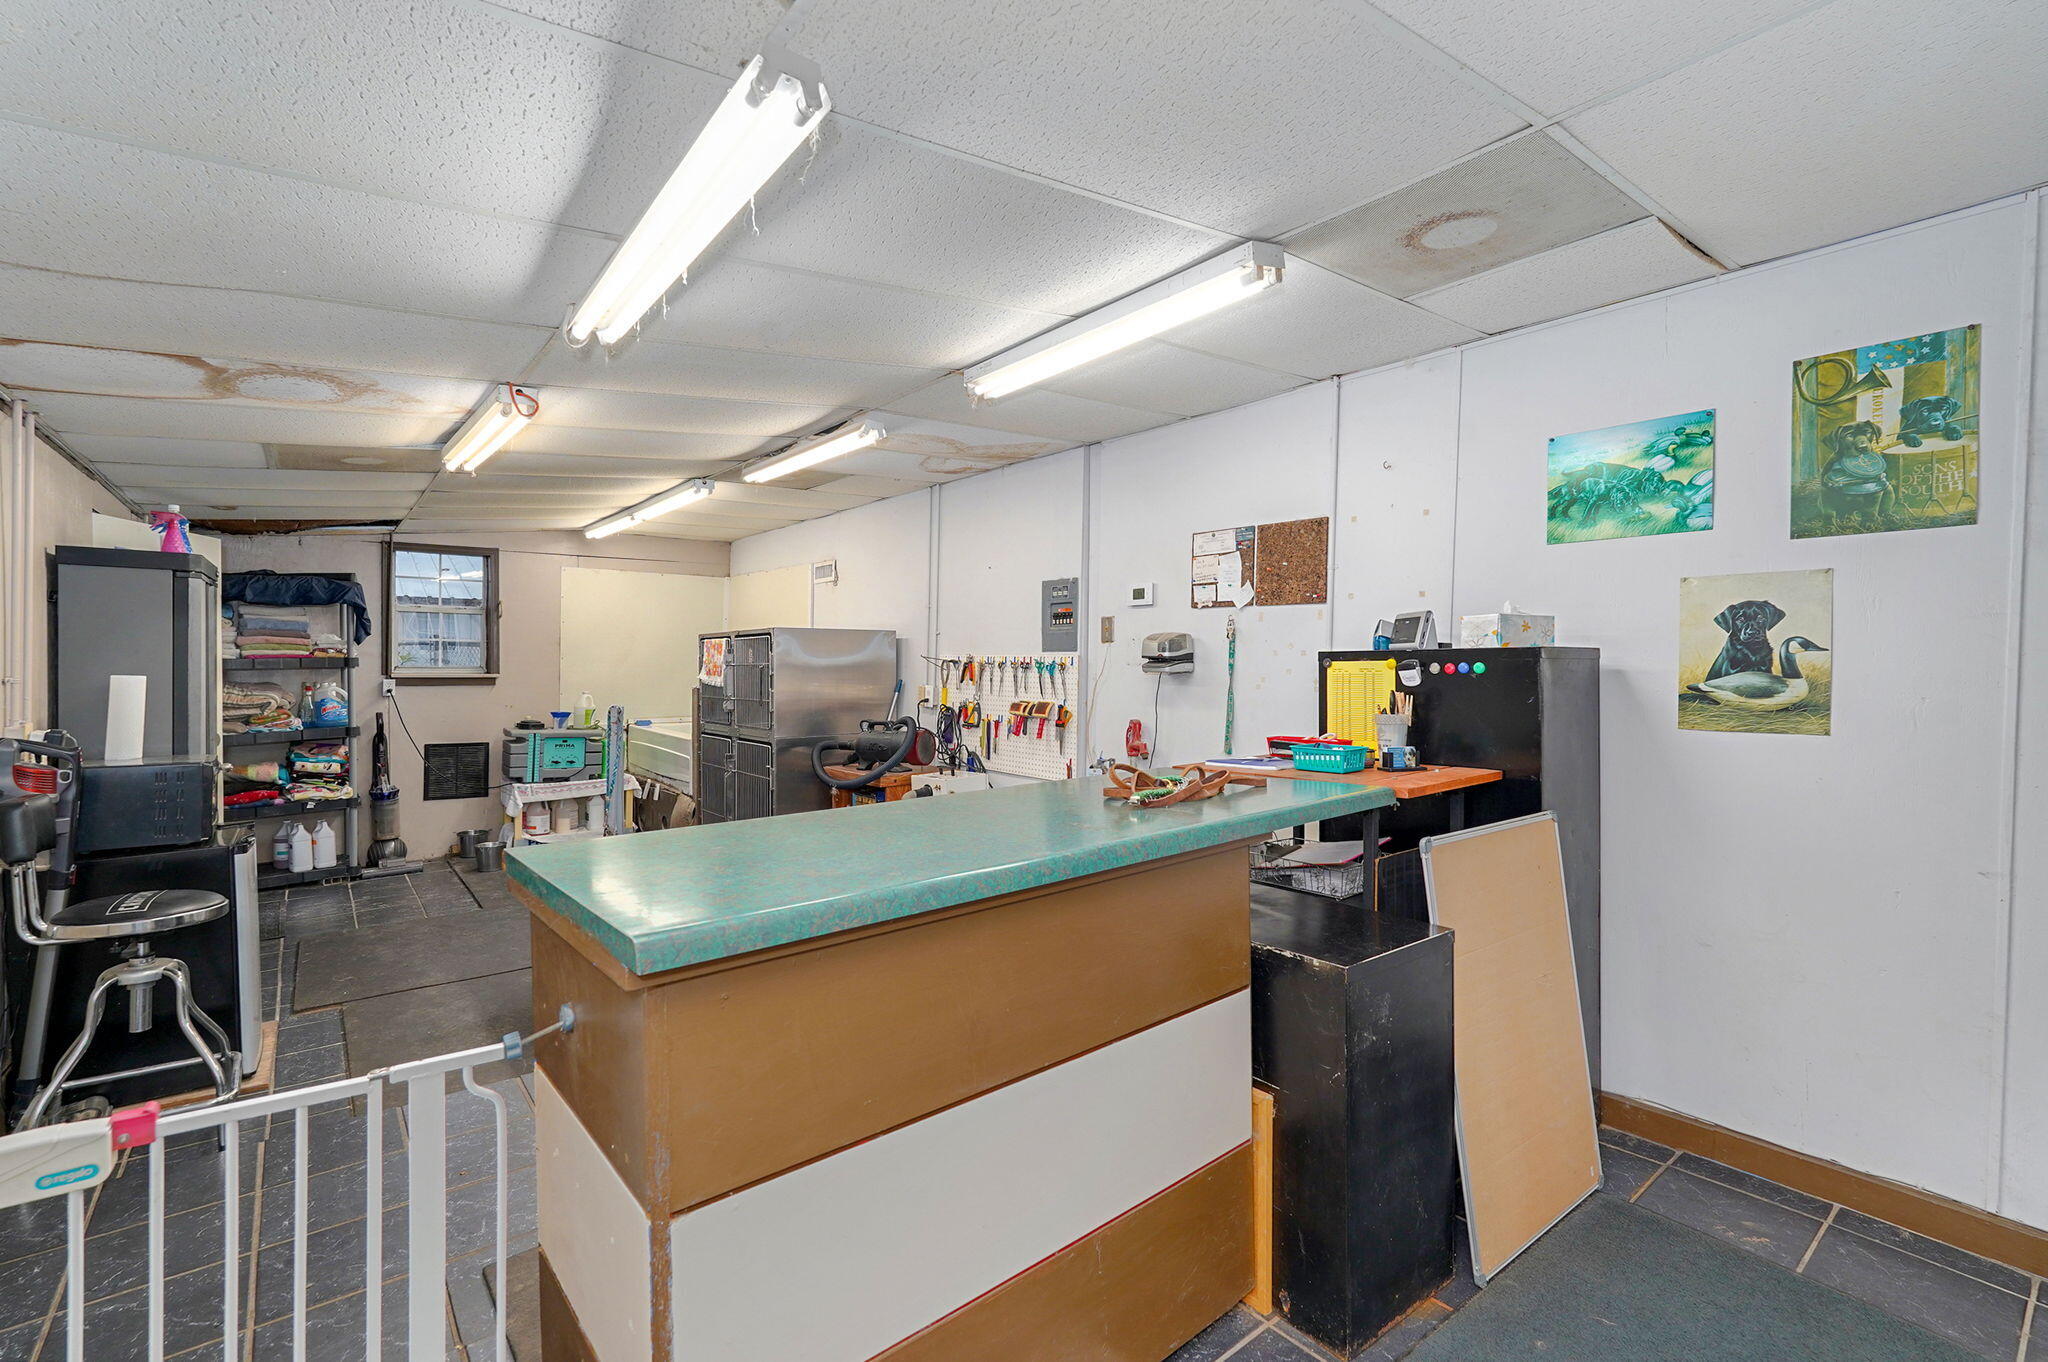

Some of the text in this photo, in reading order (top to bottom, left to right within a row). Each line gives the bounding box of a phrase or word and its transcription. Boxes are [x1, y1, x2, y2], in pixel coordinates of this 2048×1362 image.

[1912, 460, 1957, 475] SONS
[1902, 469, 1964, 486] OF THE
[1902, 480, 1965, 496] SOUTH
